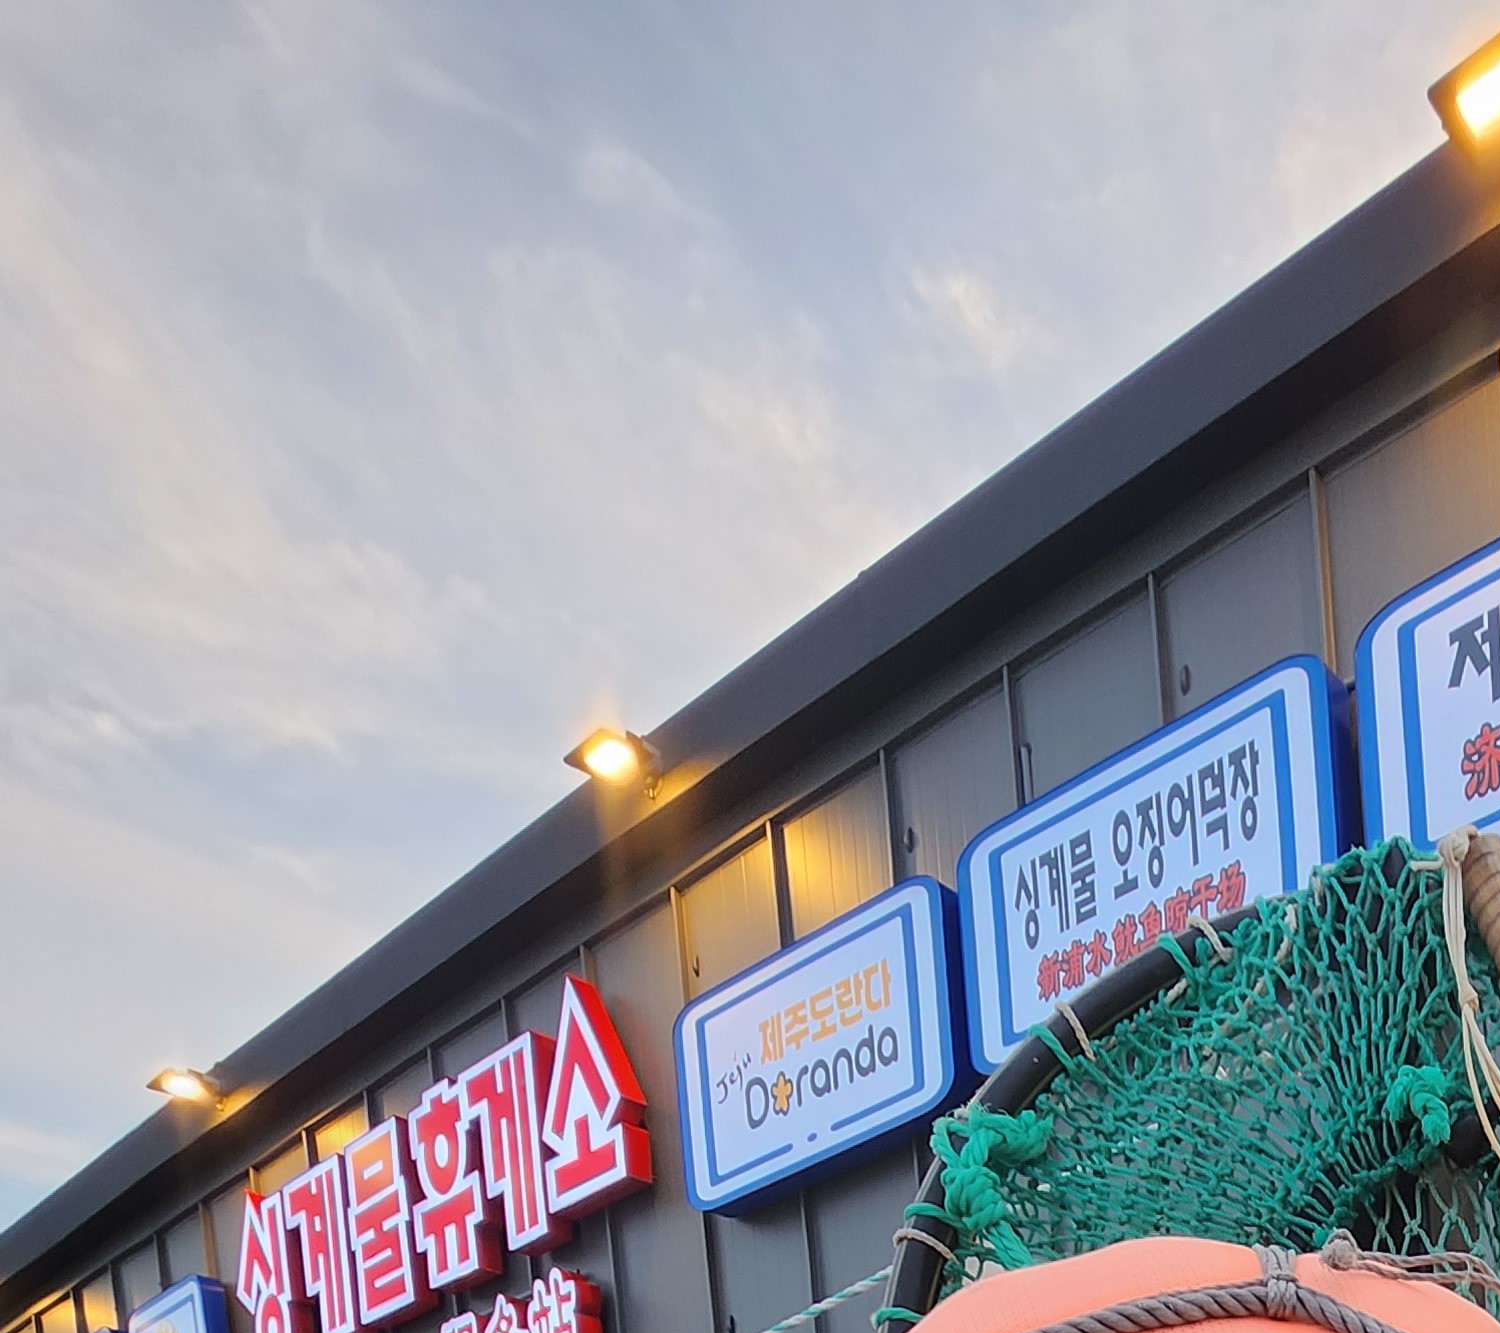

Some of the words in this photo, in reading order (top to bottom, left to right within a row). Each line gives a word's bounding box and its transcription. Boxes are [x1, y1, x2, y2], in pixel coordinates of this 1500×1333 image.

[1014, 828, 1098, 951] 싱계물
[1111, 738, 1261, 900] 오징어덕장
[758, 957, 892, 1066] 제주도란다
